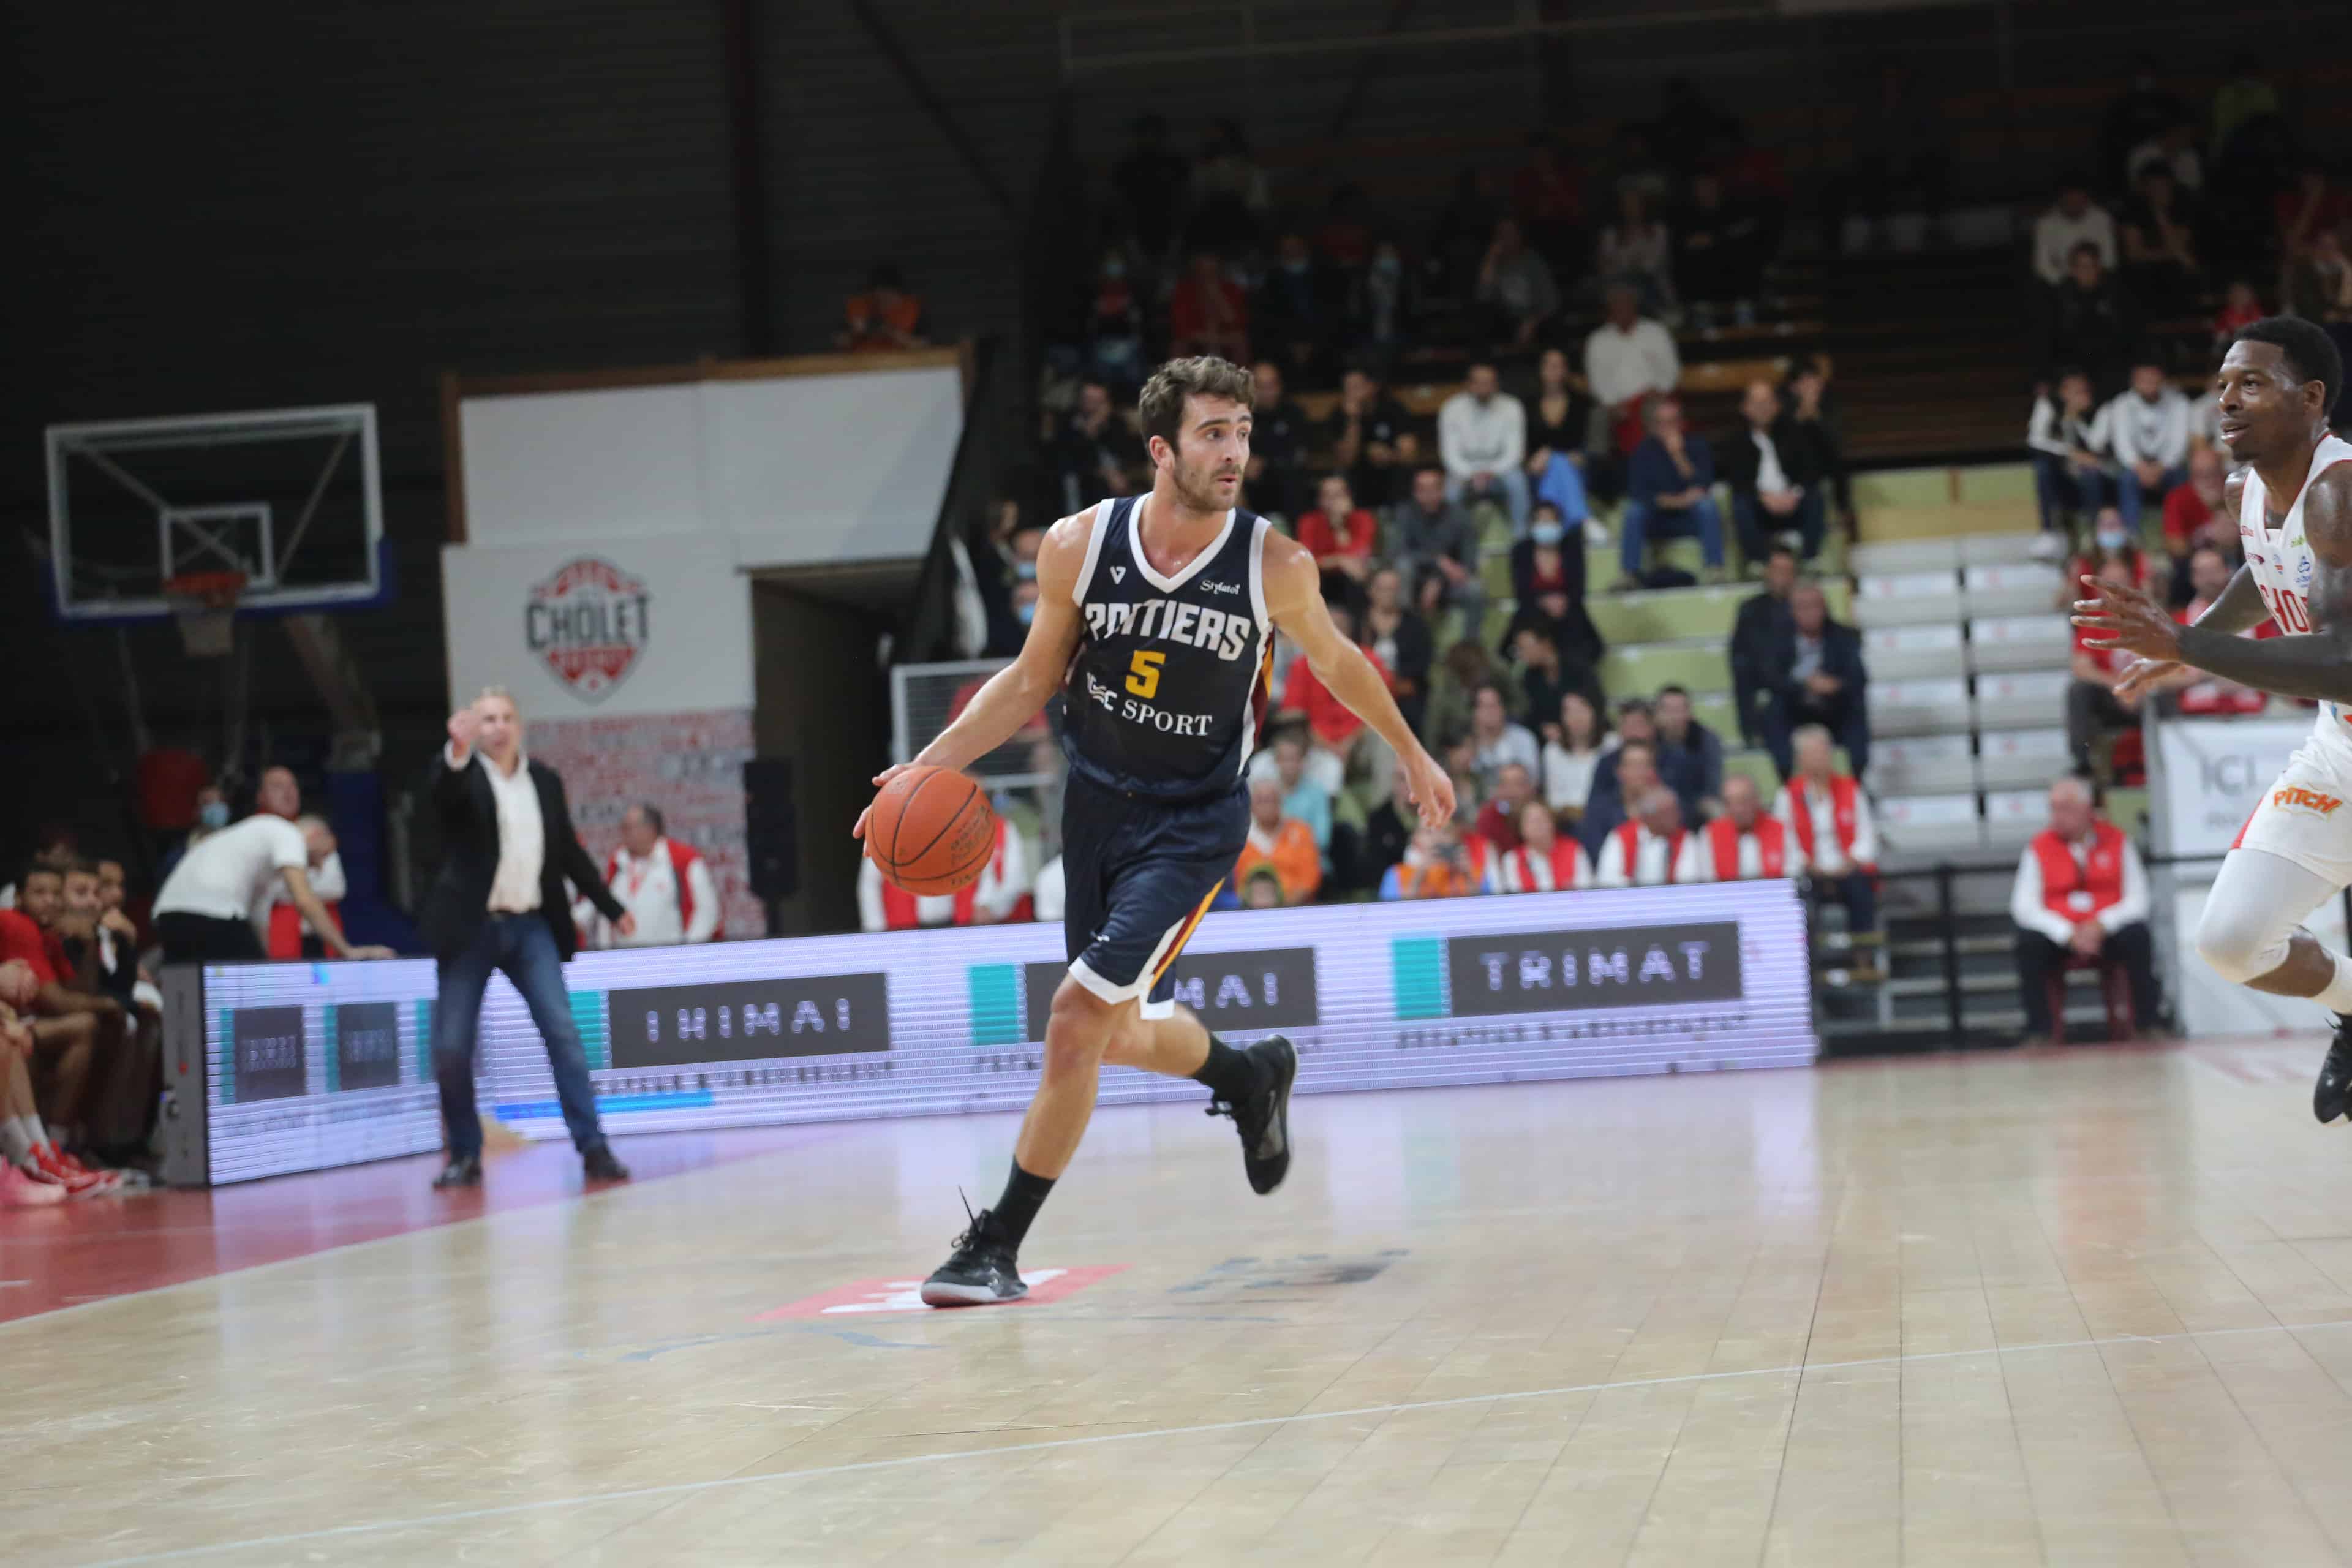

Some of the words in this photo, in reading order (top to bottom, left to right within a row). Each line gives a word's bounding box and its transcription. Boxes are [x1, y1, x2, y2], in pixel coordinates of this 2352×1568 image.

[525, 594, 652, 652] CHOLET
[1125, 650, 1166, 699] 5
[1122, 699, 1213, 736] SPORT
[1479, 940, 1711, 991] TRIMAT
